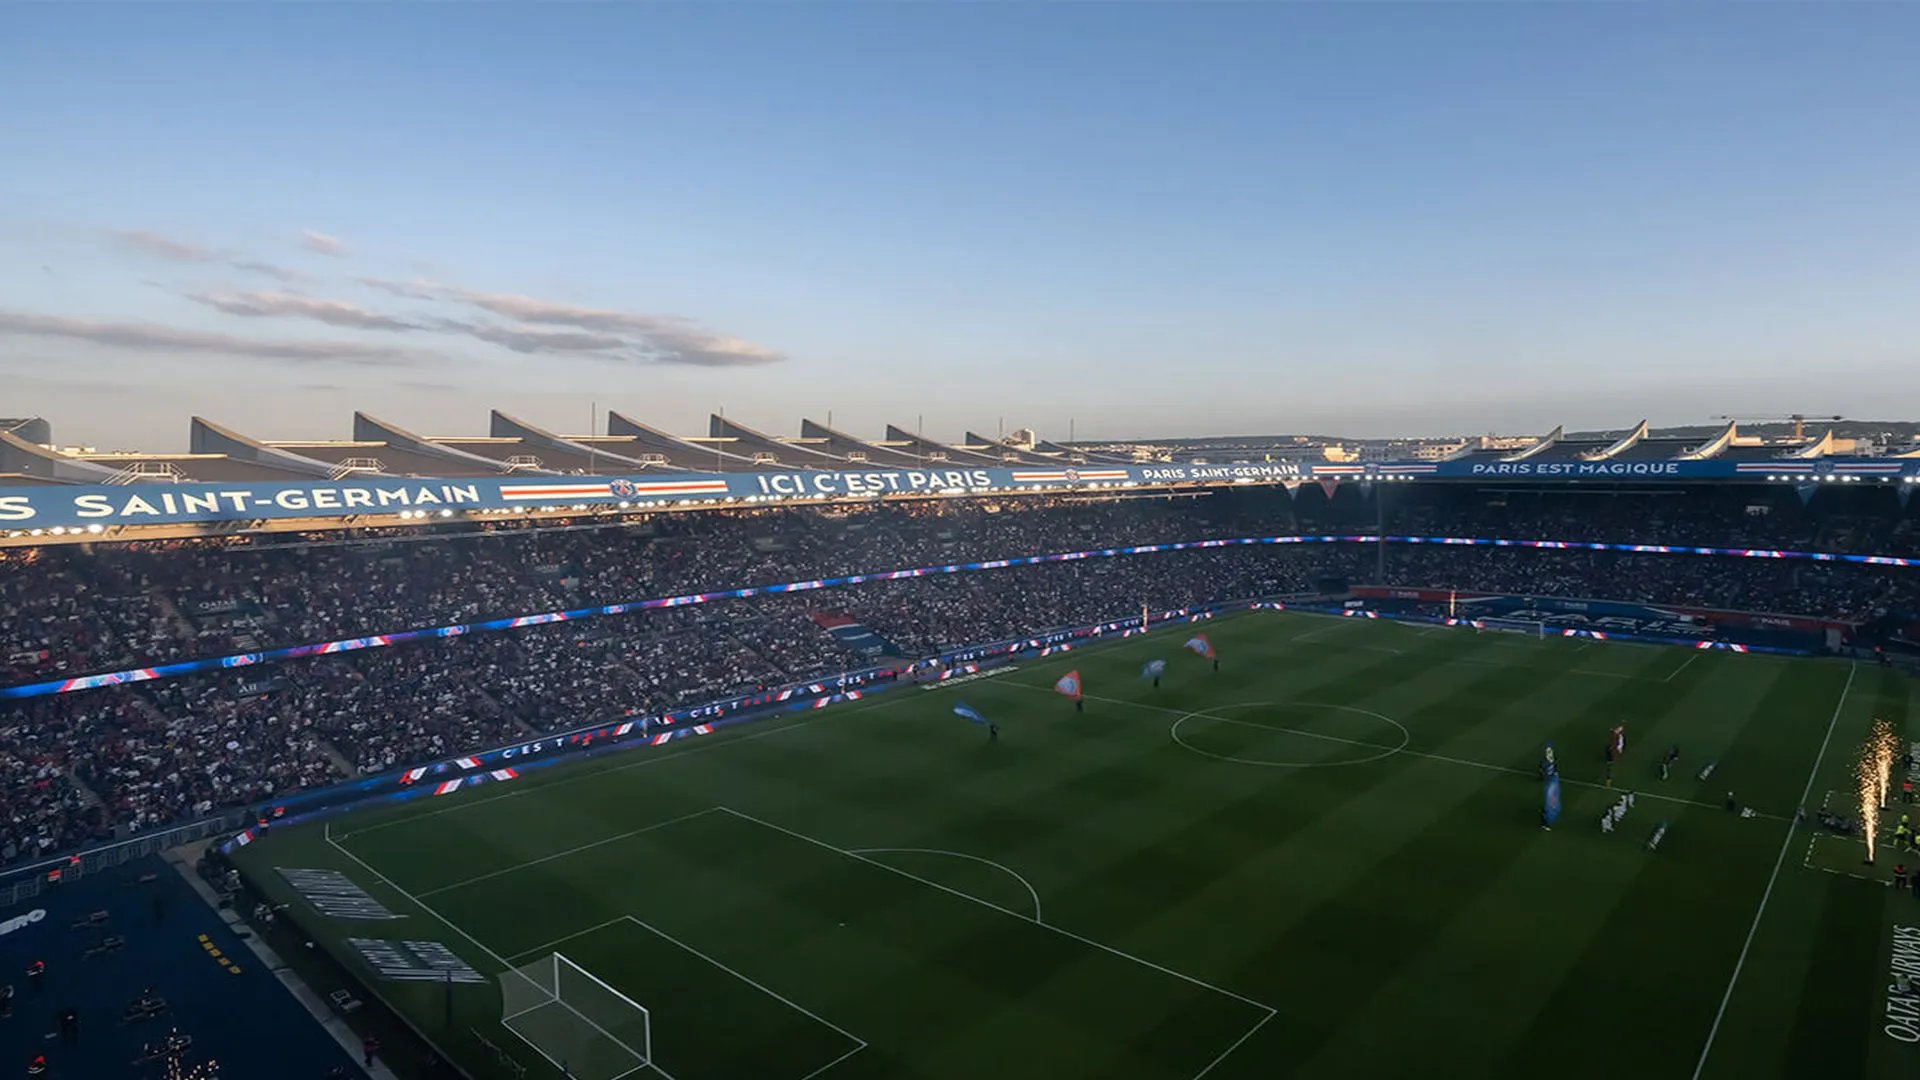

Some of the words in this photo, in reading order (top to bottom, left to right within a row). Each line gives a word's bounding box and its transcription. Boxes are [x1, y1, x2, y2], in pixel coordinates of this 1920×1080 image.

[1142, 469, 1186, 480] PARIS
[1190, 465, 1300, 479] SAINT-GERMAIN
[1472, 463, 1530, 474] PARIS
[1536, 463, 1574, 474] EST
[1579, 463, 1679, 474] MAGIQUE
[757, 475, 804, 494] ICI
[813, 473, 899, 492] C'EST
[907, 470, 991, 489] PARIS
[73, 484, 480, 518] SAINT-GERMAIN
